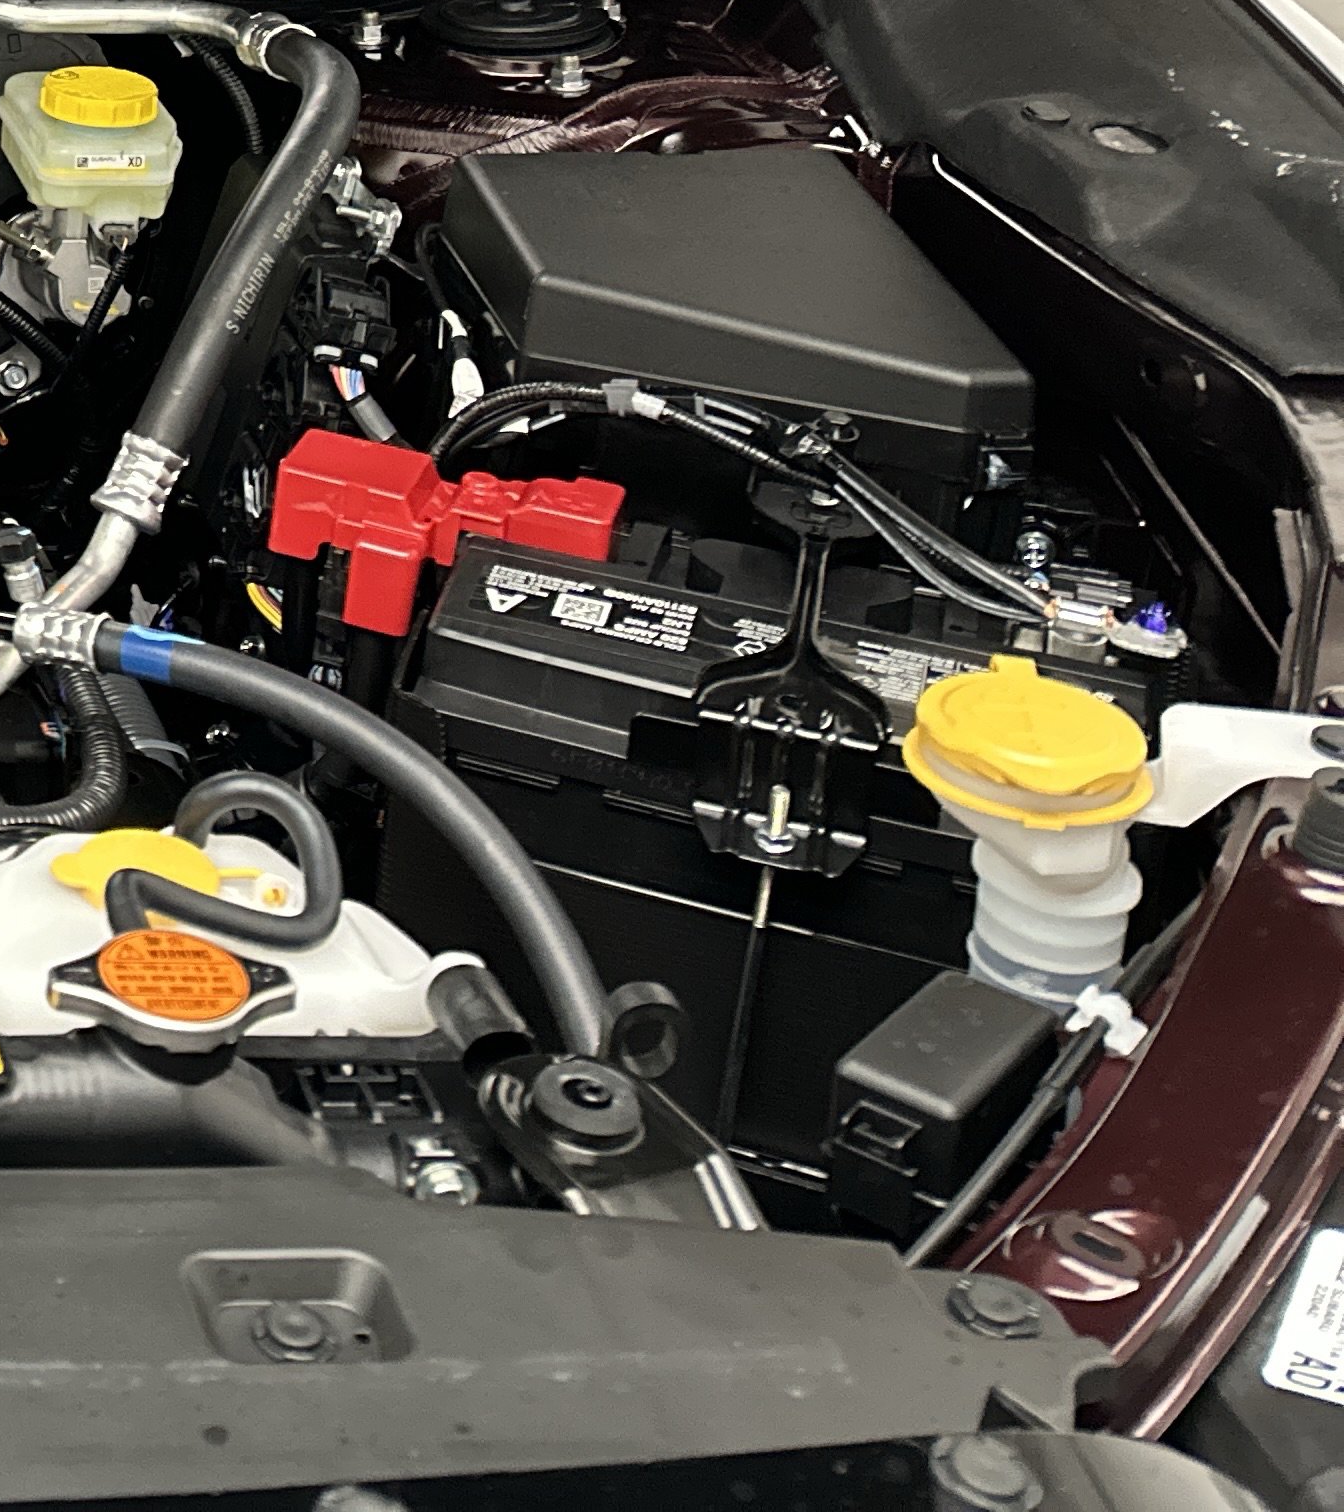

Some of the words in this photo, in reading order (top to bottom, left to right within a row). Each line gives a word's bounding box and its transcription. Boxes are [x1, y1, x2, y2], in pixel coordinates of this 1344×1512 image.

[128, 157, 142, 167] XD
[234, 252, 277, 320] NICHIRIN
[1286, 1352, 1336, 1390] AD
